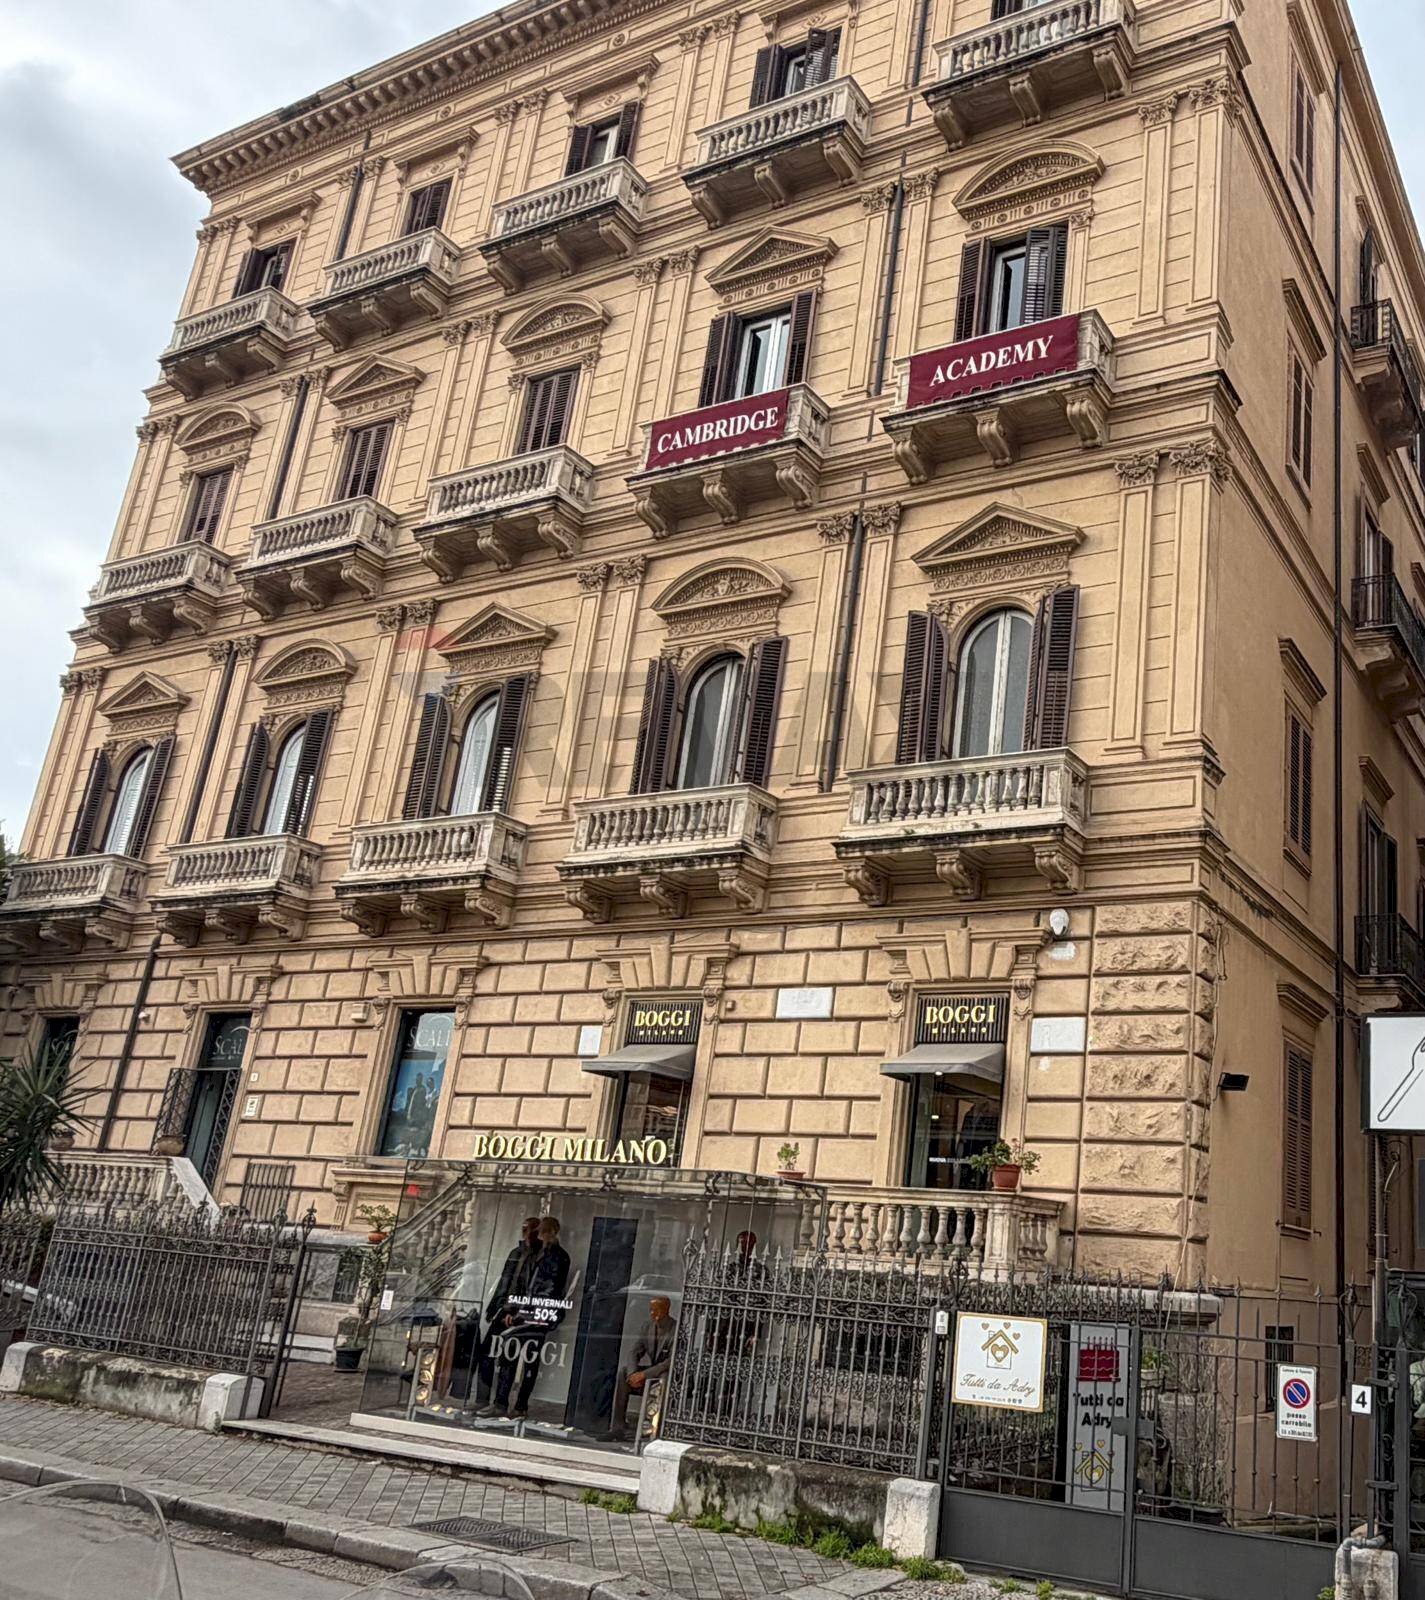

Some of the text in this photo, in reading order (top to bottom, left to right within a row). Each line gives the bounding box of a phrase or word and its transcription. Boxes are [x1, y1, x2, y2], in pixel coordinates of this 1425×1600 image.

[929, 335, 1054, 387] ACADEMY
[656, 406, 779, 454] CAMBRIDGE
[634, 1010, 691, 1027] BOGGI
[925, 1005, 996, 1024] BOGGI
[473, 1134, 667, 1165] BOGGI MILANO
[508, 1295, 574, 1310] SALDI INVERNALI
[487, 1334, 569, 1368] BOGGI
[960, 1373, 988, 1389] Tutti
[986, 1378, 1002, 1391] da
[1002, 1378, 1037, 1399] Adry
[1355, 1390, 1368, 1409] 4
